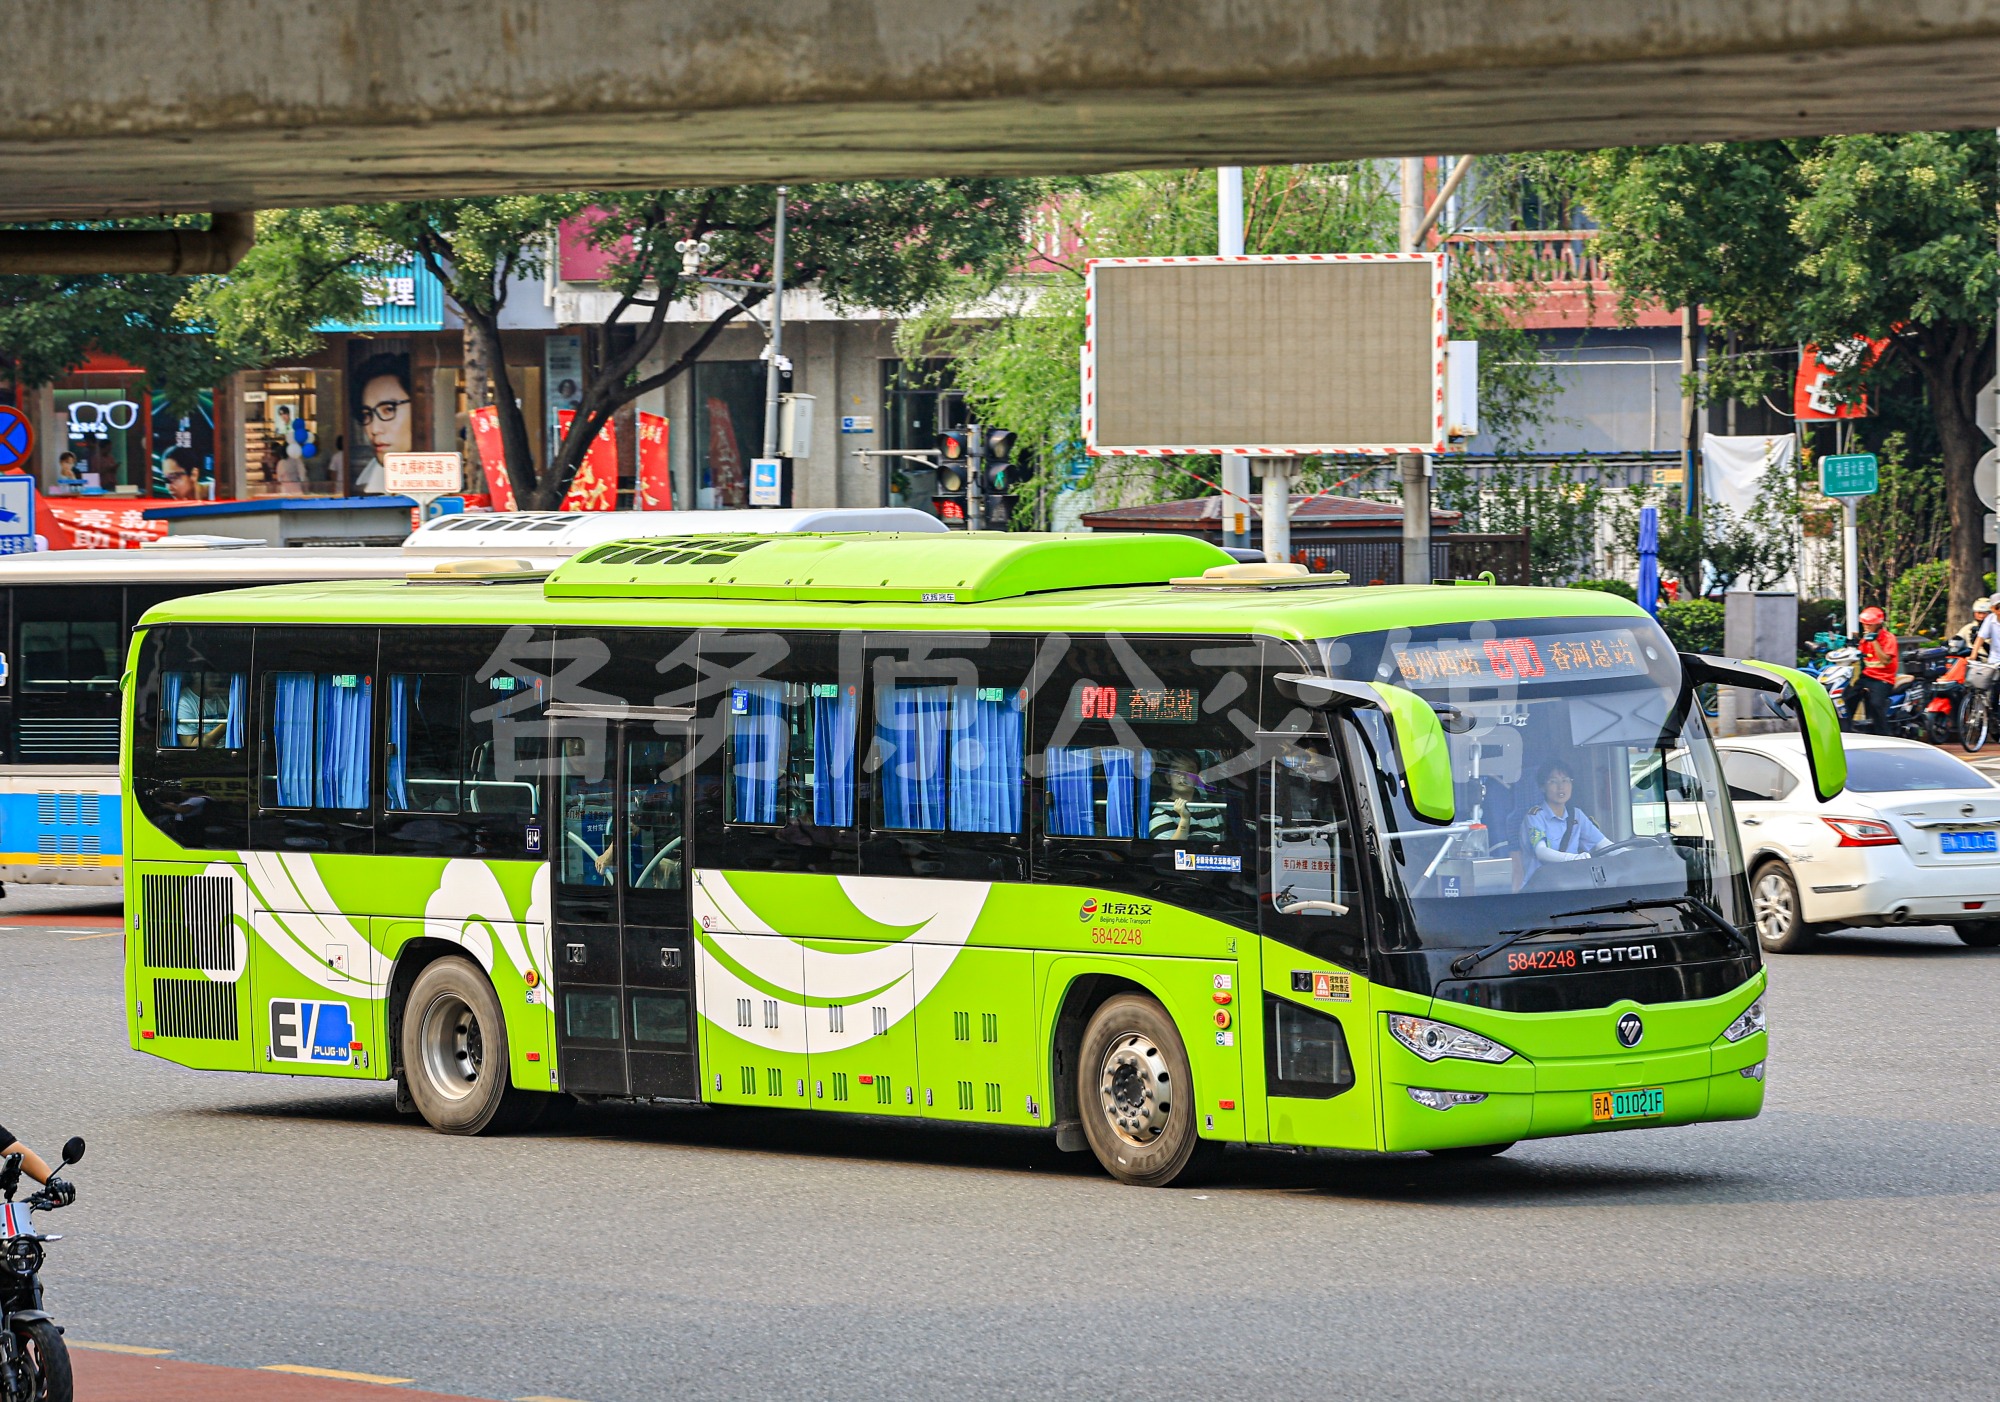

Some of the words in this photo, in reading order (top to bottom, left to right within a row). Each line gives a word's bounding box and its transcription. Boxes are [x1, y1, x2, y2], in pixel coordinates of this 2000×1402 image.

[1397, 647, 1481, 681] 通州西站
[1483, 638, 1546, 679] 810
[1548, 639, 1636, 671] 香河总站
[1081, 686, 1118, 719] 810
[1129, 688, 1194, 721] 香河总站
[587, 823, 608, 832] 支付宝
[1311, 860, 1336, 872] 注意安全
[1101, 902, 1153, 916] 北京公交
[1100, 916, 1115, 925] Beijing
[1116, 916, 1129, 925] Public
[1092, 927, 1143, 946] 5842248
[1508, 950, 1576, 971] 5842248
[1581, 944, 1657, 964] FOTON
[314, 1045, 347, 1057] PLUG-IN
